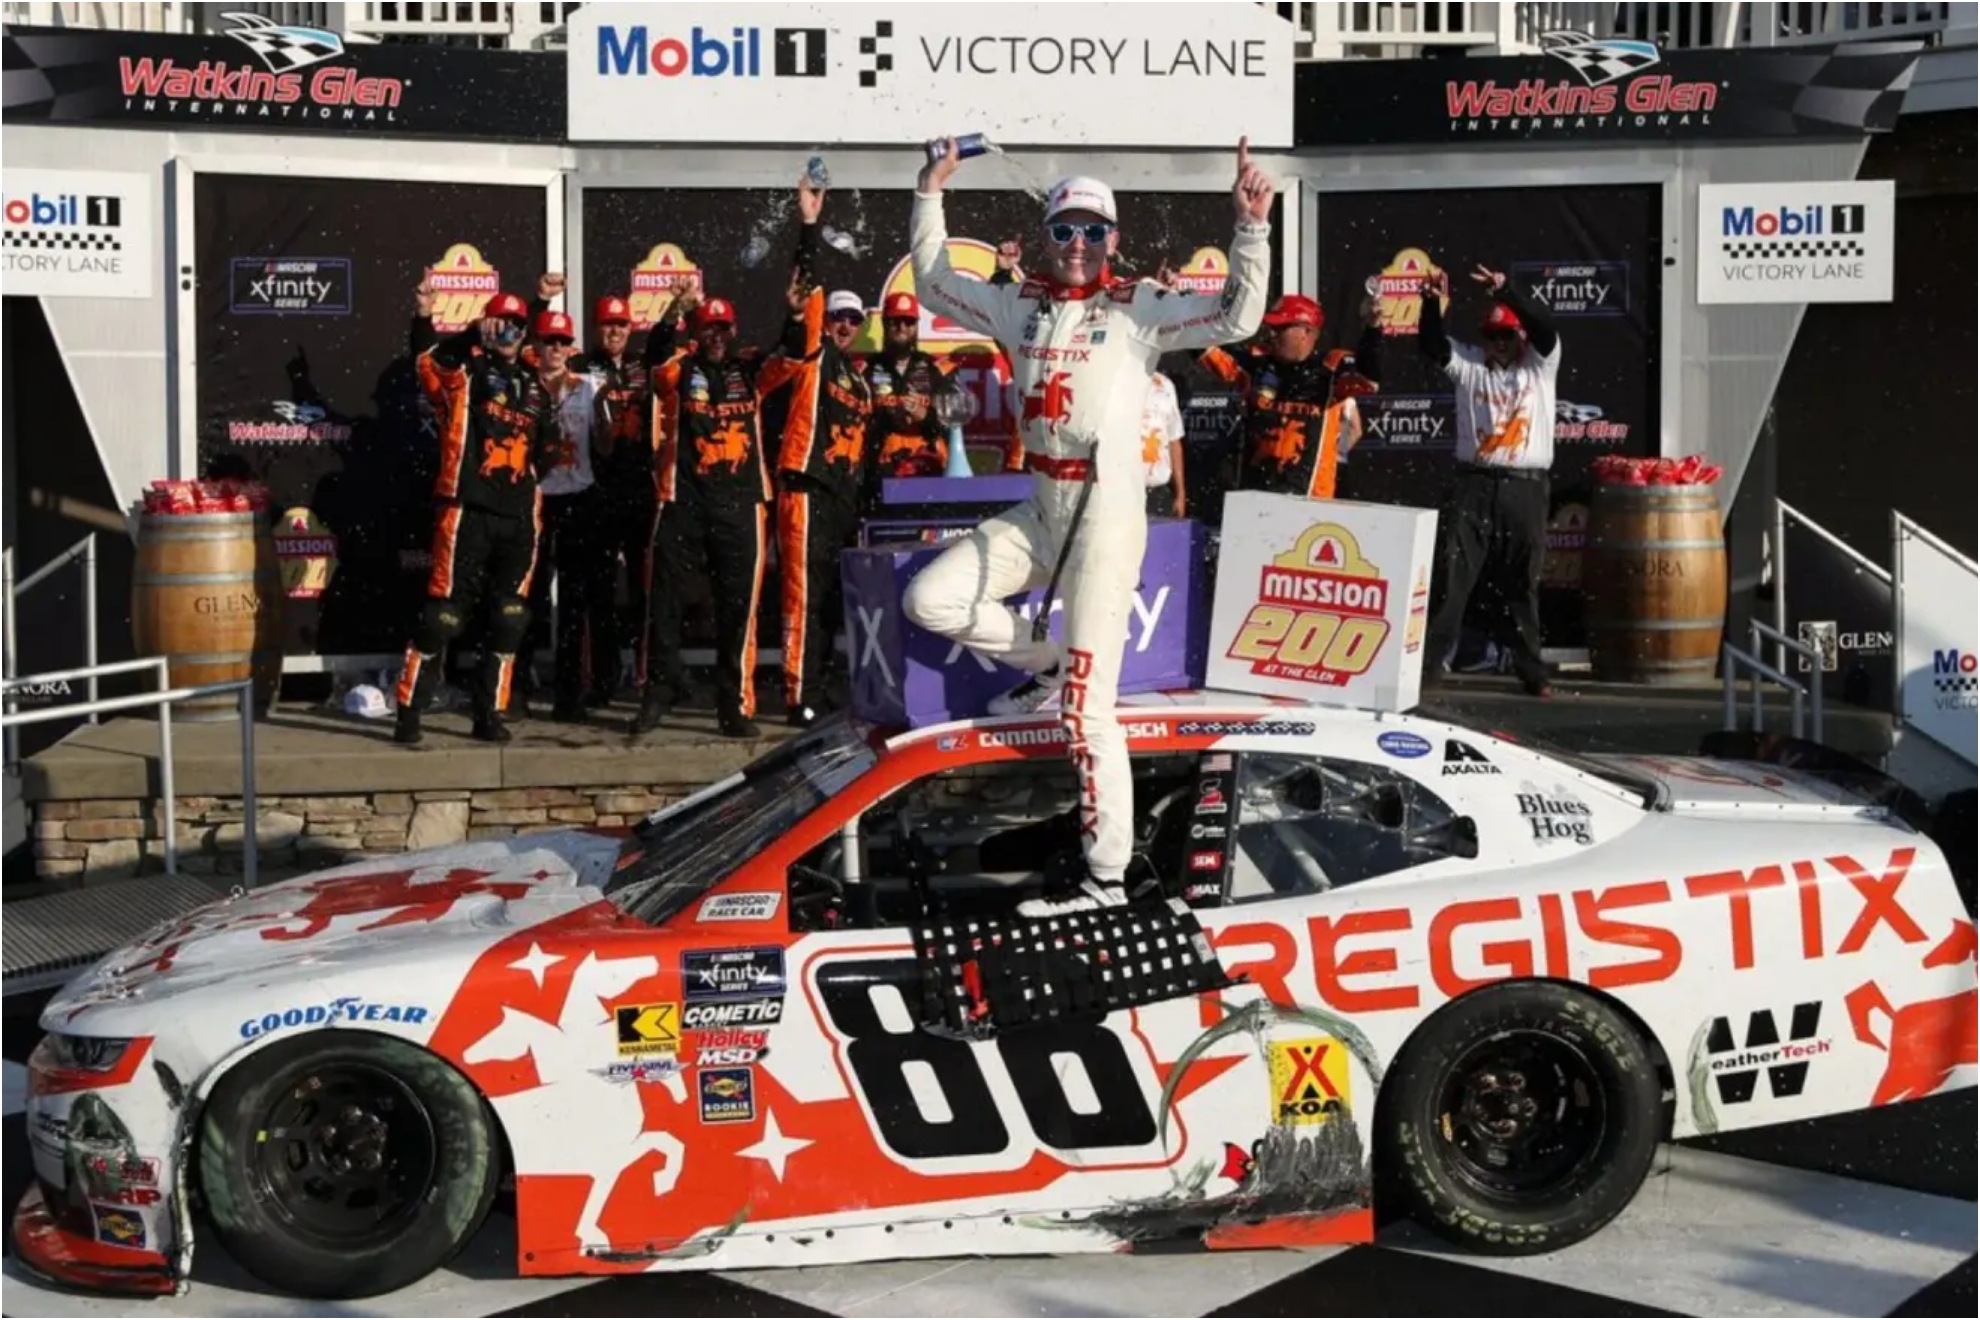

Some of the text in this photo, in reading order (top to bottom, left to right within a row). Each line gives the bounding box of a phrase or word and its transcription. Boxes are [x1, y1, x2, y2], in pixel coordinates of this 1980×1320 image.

[597, 26, 760, 77] Mobil
[920, 35, 1128, 75] VICTORY
[1144, 38, 1267, 78] LANE
[119, 57, 402, 107] Watkins Glen
[1446, 75, 1717, 119] Watkins Glen
[125, 99, 398, 122] INTERNATIONAL
[1450, 113, 1712, 131] INTERNATIONAL
[2, 193, 77, 225] obil
[1722, 204, 1822, 237] Mobil
[2, 254, 122, 274] TORY LANE
[1723, 263, 1865, 281] VICTORY LANE
[250, 275, 332, 302] xfinity
[430, 274, 496, 290] MISSION
[1177, 276, 1226, 291] MISSI
[1531, 278, 1611, 306] xfinity
[1553, 301, 1587, 312] SERIES
[1182, 411, 1242, 437] finity
[1367, 411, 1445, 438] xfinity
[1389, 433, 1422, 444] SERIES
[1264, 572, 1383, 611] MISSION
[193, 593, 258, 614] GLEN
[1227, 604, 1389, 675] 200
[1838, 631, 1894, 649] GLEN
[1261, 663, 1337, 684] AT THE GLEN
[978, 727, 1065, 748] CONNOR
[1441, 764, 1503, 777] AXALTA
[1515, 792, 1593, 817] Blues
[1530, 816, 1593, 846] Hog
[707, 906, 766, 918] RACE CAR
[1200, 847, 1929, 1028] REGISTIX
[699, 962, 769, 988] xfinity
[683, 998, 781, 1025] COMETIC
[696, 1027, 769, 1050] Holley
[696, 1047, 758, 1067] MSD
[1279, 1099, 1343, 1119] KOA
